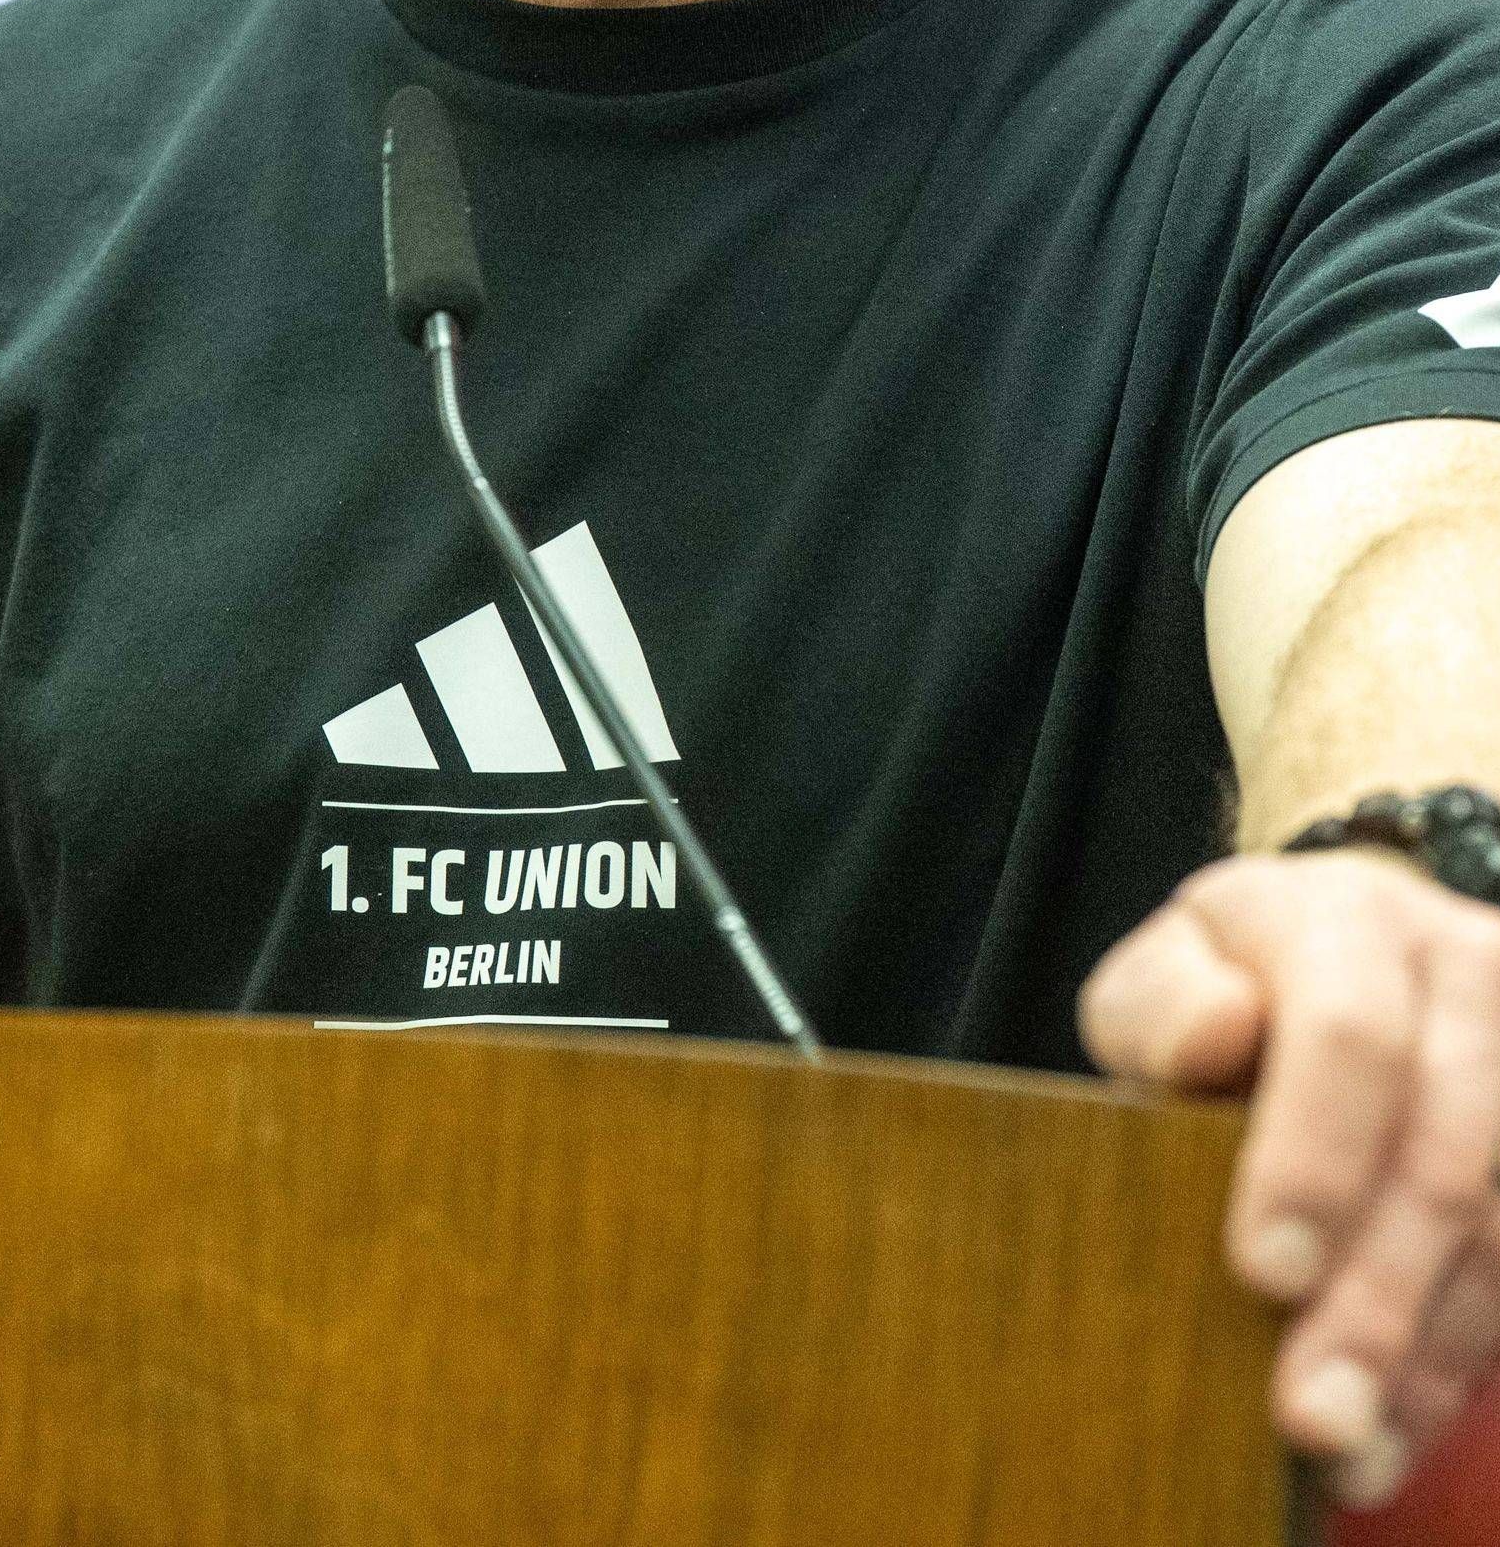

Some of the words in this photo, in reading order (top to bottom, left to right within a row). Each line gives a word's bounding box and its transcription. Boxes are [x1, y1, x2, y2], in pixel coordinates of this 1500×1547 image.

[321, 844, 370, 913] 1.
[391, 847, 466, 916] FC
[484, 840, 677, 915] UNION
[422, 939, 562, 989] BERLIN
